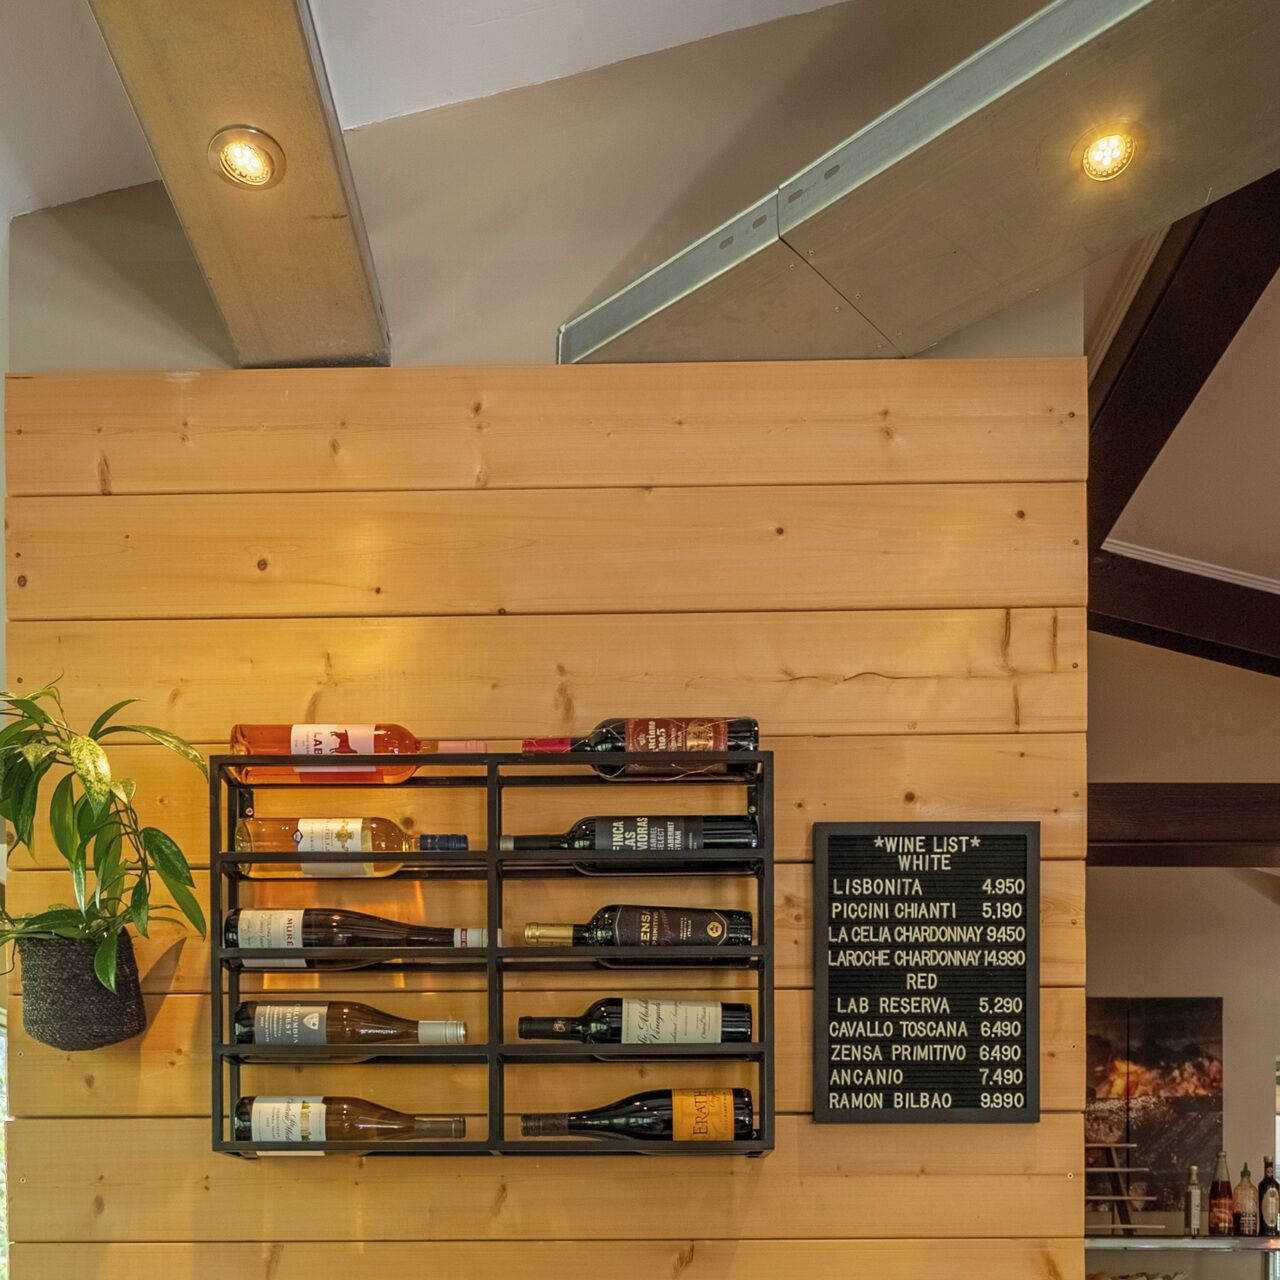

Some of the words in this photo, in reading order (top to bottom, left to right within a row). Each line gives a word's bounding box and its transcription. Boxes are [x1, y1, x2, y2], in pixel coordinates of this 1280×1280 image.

[313, 732, 323, 755] LAB
[624, 831, 636, 851] AS
[649, 827, 658, 850] ARREL
[898, 854, 952, 871] WHITE
[833, 878, 923, 896] LISBONITA
[982, 878, 1026, 895] 4.950
[832, 902, 890, 919] PICCINI
[894, 902, 956, 919] CHIANTI
[982, 902, 1023, 920] 5.190
[828, 926, 849, 943] LA
[851, 926, 891, 943] CELIA
[894, 926, 984, 943] CHARDONNAY
[828, 950, 891, 967] LAROCHE
[894, 950, 982, 967] CHARDONNAY
[983, 950, 1026, 967] 14.990
[906, 973, 938, 990] RED
[837, 997, 869, 1014] LAB
[879, 997, 951, 1014] RESERVA
[979, 997, 1023, 1014] 5.290
[829, 1021, 894, 1038] CAVALLO
[899, 1021, 969, 1038] TOSCANA
[980, 1021, 1022, 1038] 6.490
[831, 1045, 883, 1062] ZENSA
[892, 1045, 967, 1062] PRIMITIVO
[979, 1044, 1022, 1062] 6.490
[830, 1069, 904, 1086] ANCANIO
[979, 1068, 1024, 1086] 7.490
[829, 1092, 884, 1110] RAMON
[894, 1092, 952, 1110] BILBAO
[693, 1089, 709, 1136] ERATH
